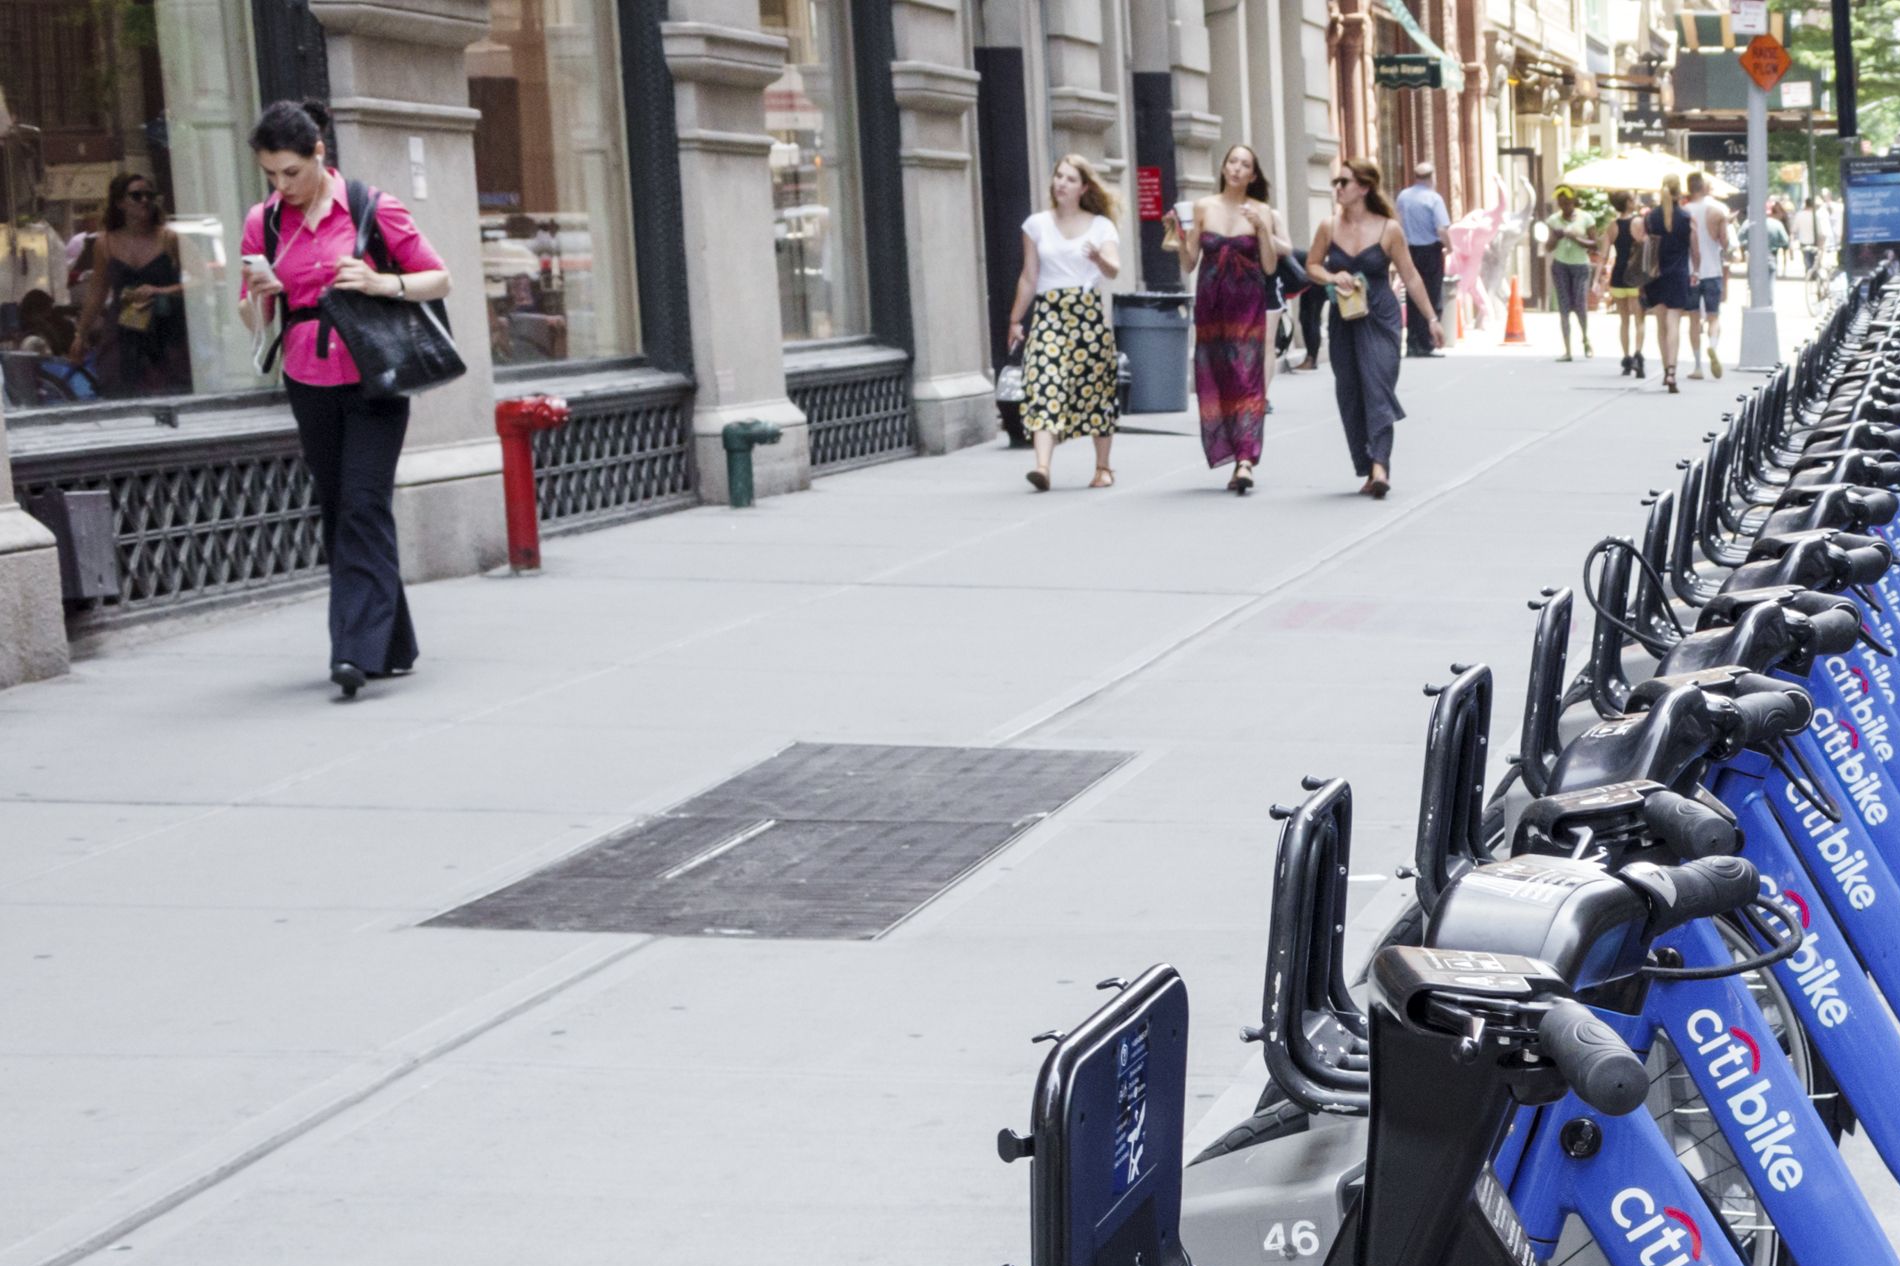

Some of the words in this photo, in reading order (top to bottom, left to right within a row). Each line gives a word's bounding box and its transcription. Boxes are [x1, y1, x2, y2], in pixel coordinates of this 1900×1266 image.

[1752, 62, 1779, 75] PLOW
[1825, 656, 1869, 703] citi
[1851, 696, 1893, 763] bike
[1810, 707, 1859, 760] citi
[1836, 751, 1888, 826] bike
[1785, 777, 1841, 838] citi
[1817, 827, 1877, 911] bike
[1786, 932, 1849, 1029] bike
[1687, 1008, 1761, 1091] citi
[1727, 1078, 1804, 1192] bike
[1263, 1220, 1320, 1257] 46
